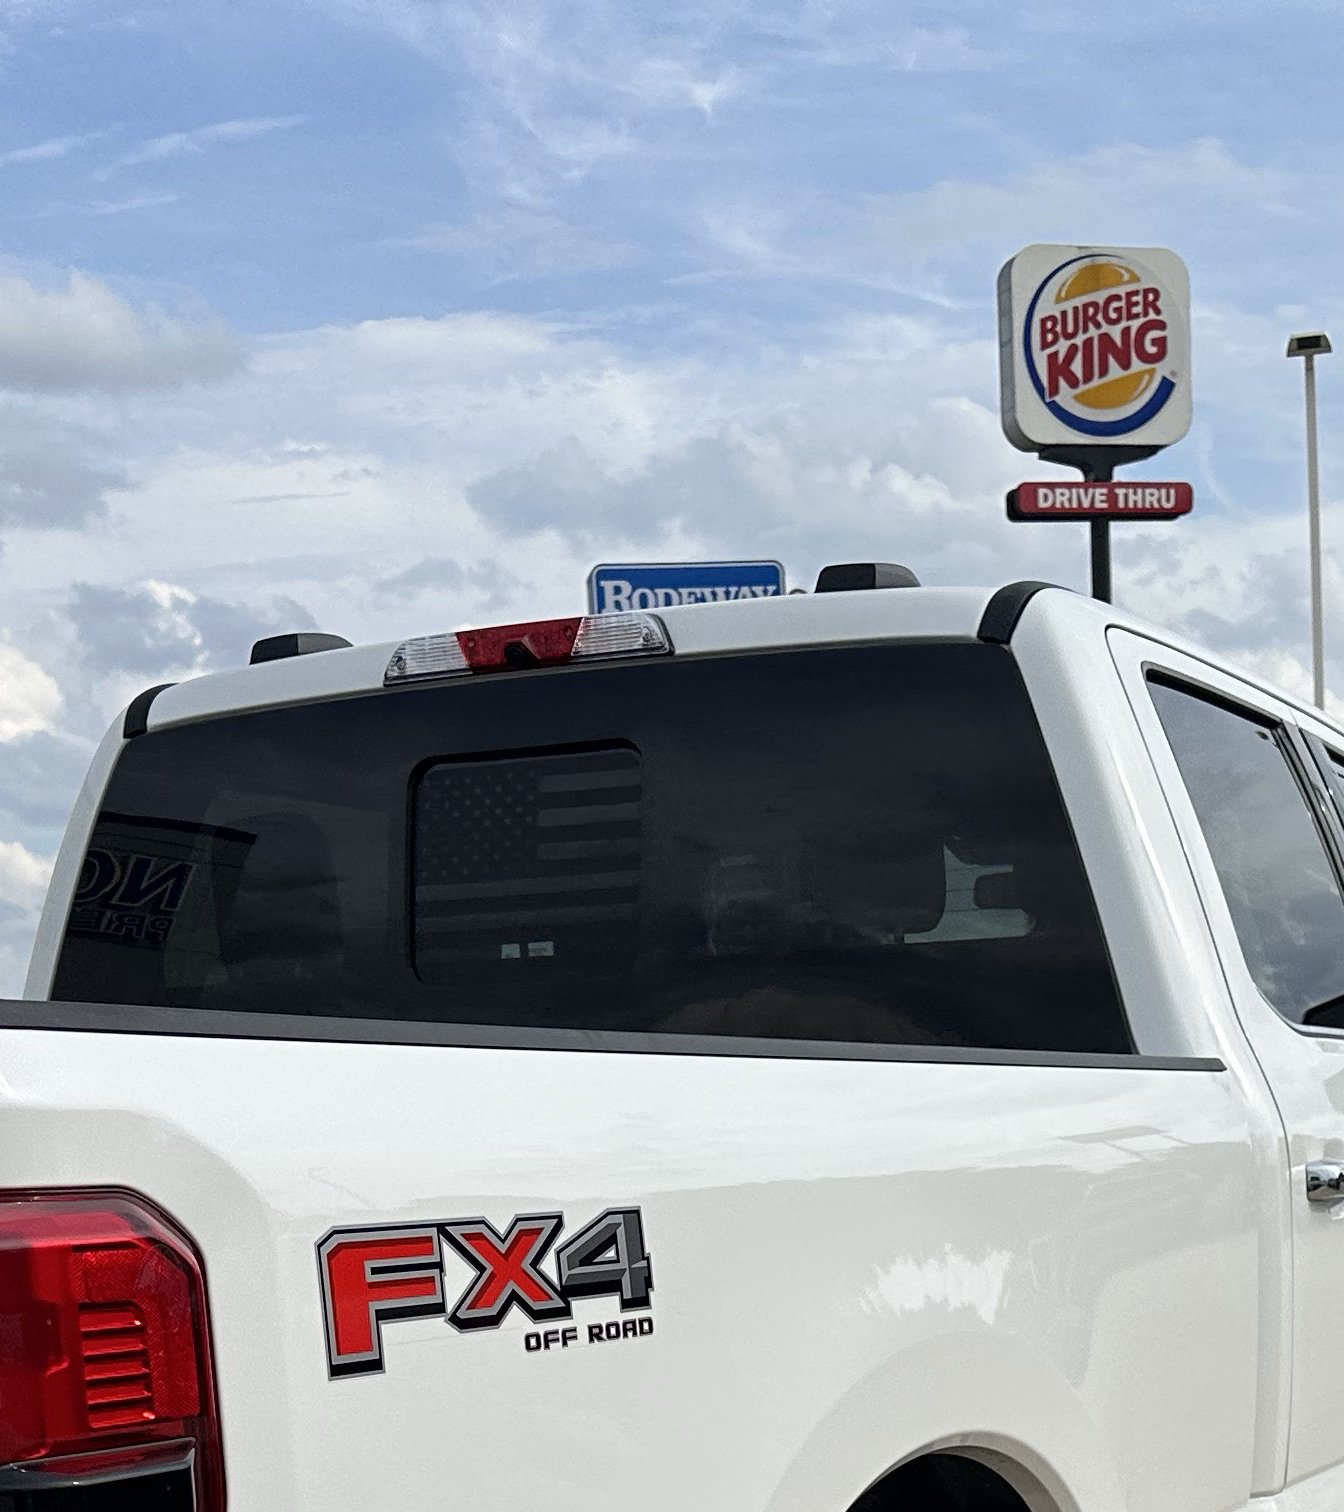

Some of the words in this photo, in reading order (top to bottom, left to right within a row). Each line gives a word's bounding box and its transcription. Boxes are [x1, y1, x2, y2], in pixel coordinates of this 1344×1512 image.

[1039, 286, 1162, 351] BURGER
[1045, 318, 1168, 400] KING
[1036, 487, 1108, 509] DRIVE
[1115, 487, 1177, 509] THRU
[314, 1205, 654, 1382] FX4
[523, 1326, 578, 1353] OFF
[587, 1316, 655, 1345] ROAD
